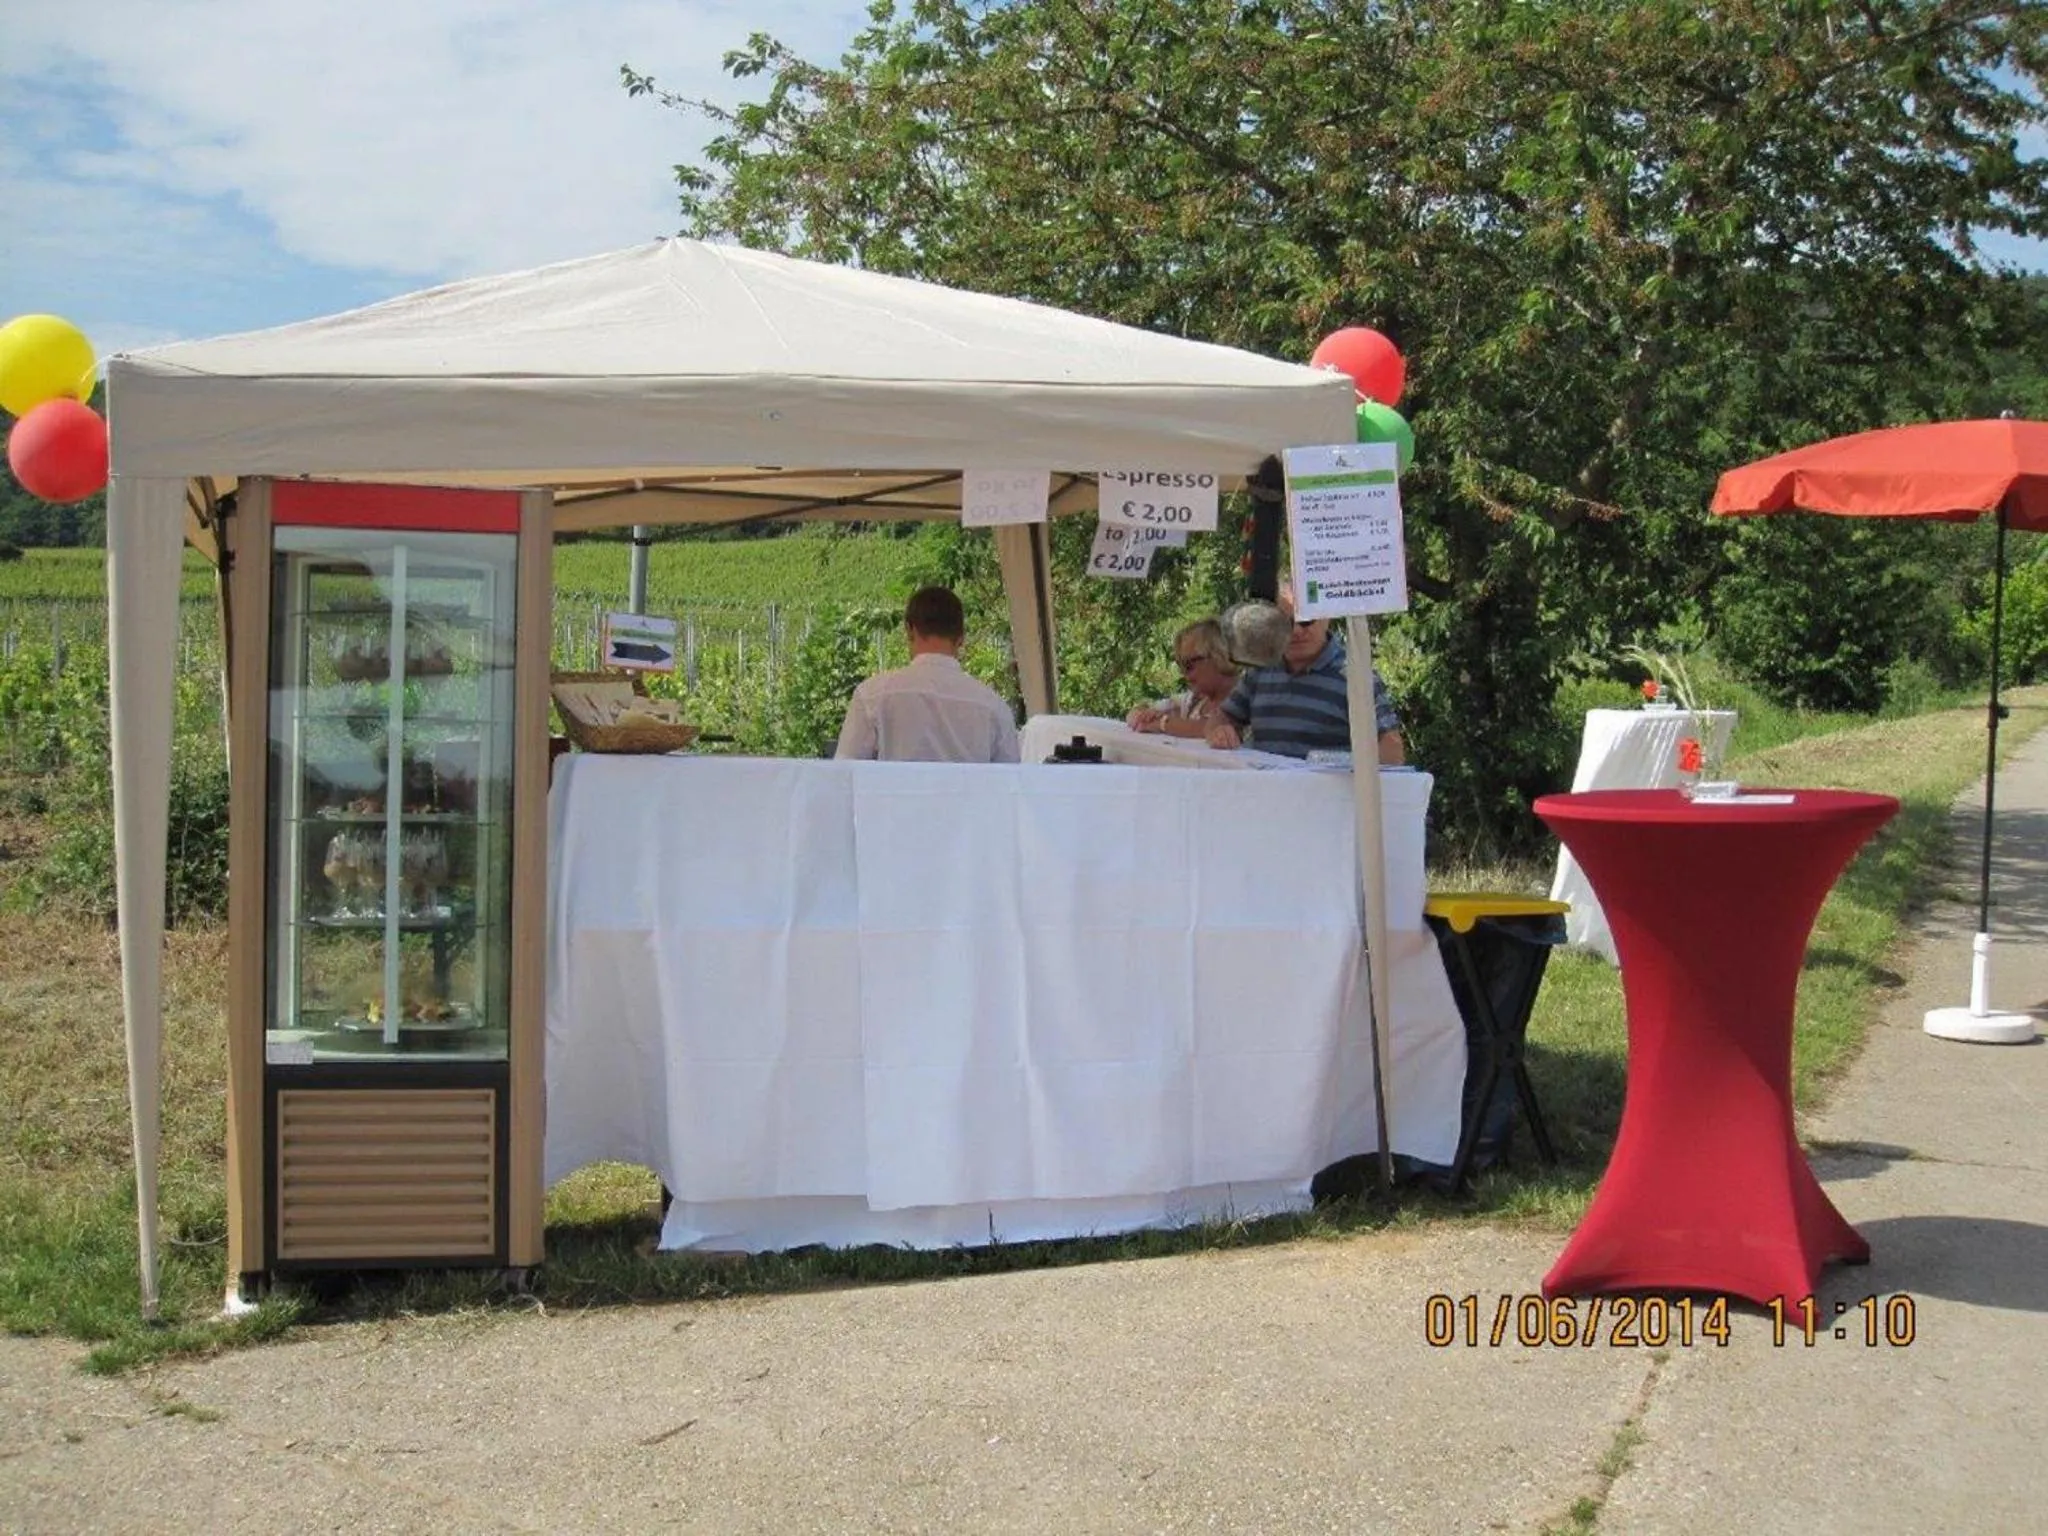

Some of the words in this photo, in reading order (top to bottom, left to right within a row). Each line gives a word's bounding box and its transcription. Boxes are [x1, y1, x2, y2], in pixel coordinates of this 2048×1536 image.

[1122, 500, 1135, 518] €
[1142, 503, 1192, 523] 2,00
[1094, 553, 1106, 568] €
[1108, 554, 1145, 571] 2,00
